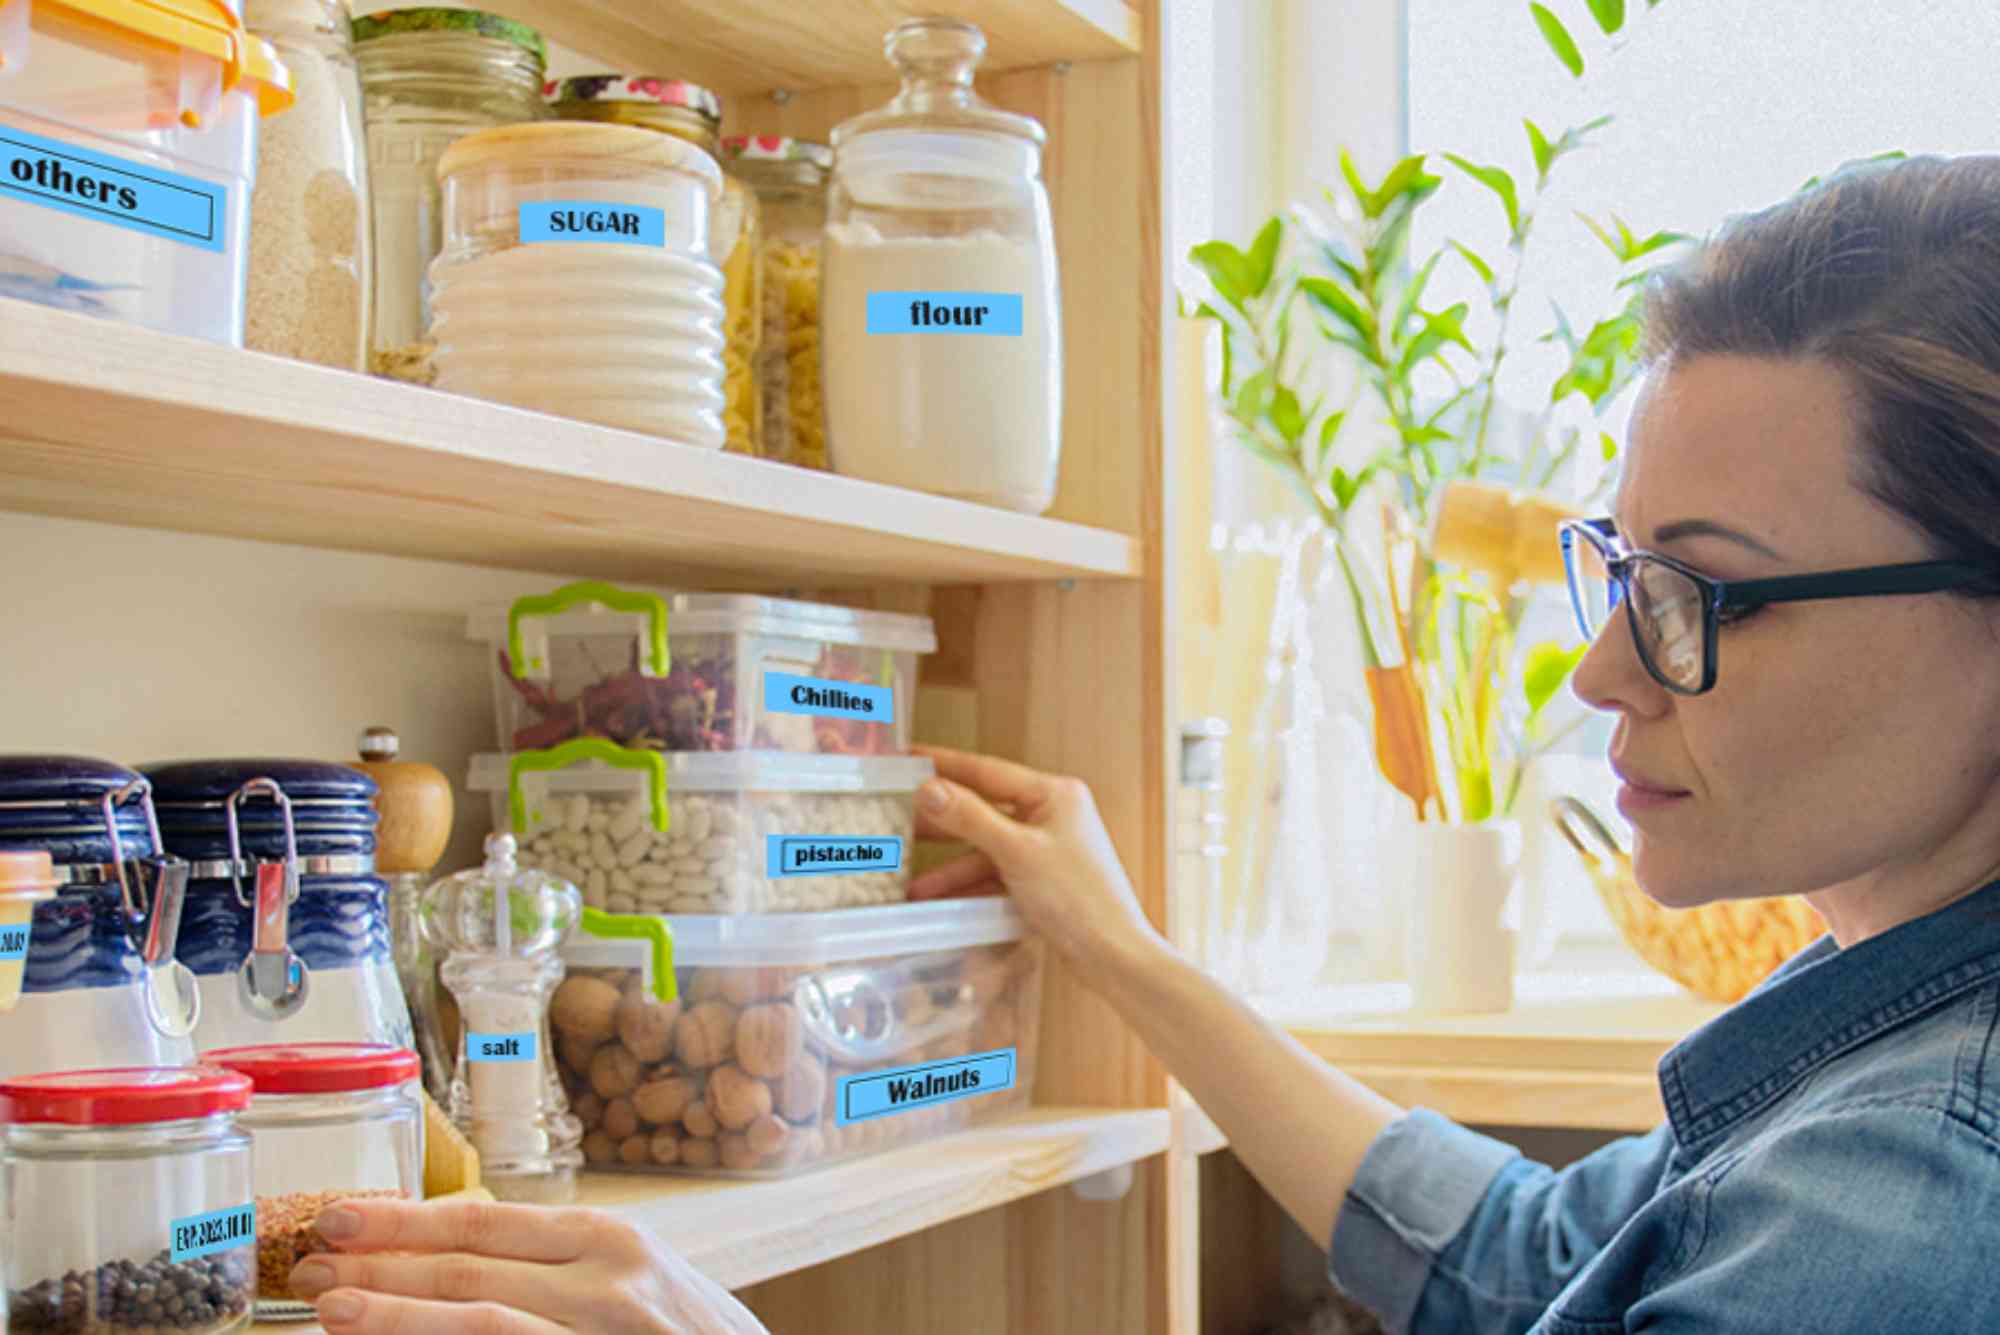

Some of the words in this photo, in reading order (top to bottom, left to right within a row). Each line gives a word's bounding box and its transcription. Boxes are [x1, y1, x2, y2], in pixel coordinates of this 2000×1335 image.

[10, 158, 138, 210] others
[549, 211, 640, 236] SUGAR
[909, 301, 988, 326] flour
[790, 684, 874, 713] Chillies
[794, 842, 884, 869] pistachio
[481, 1039, 520, 1057] salt
[888, 1069, 981, 1104] Walnuts
